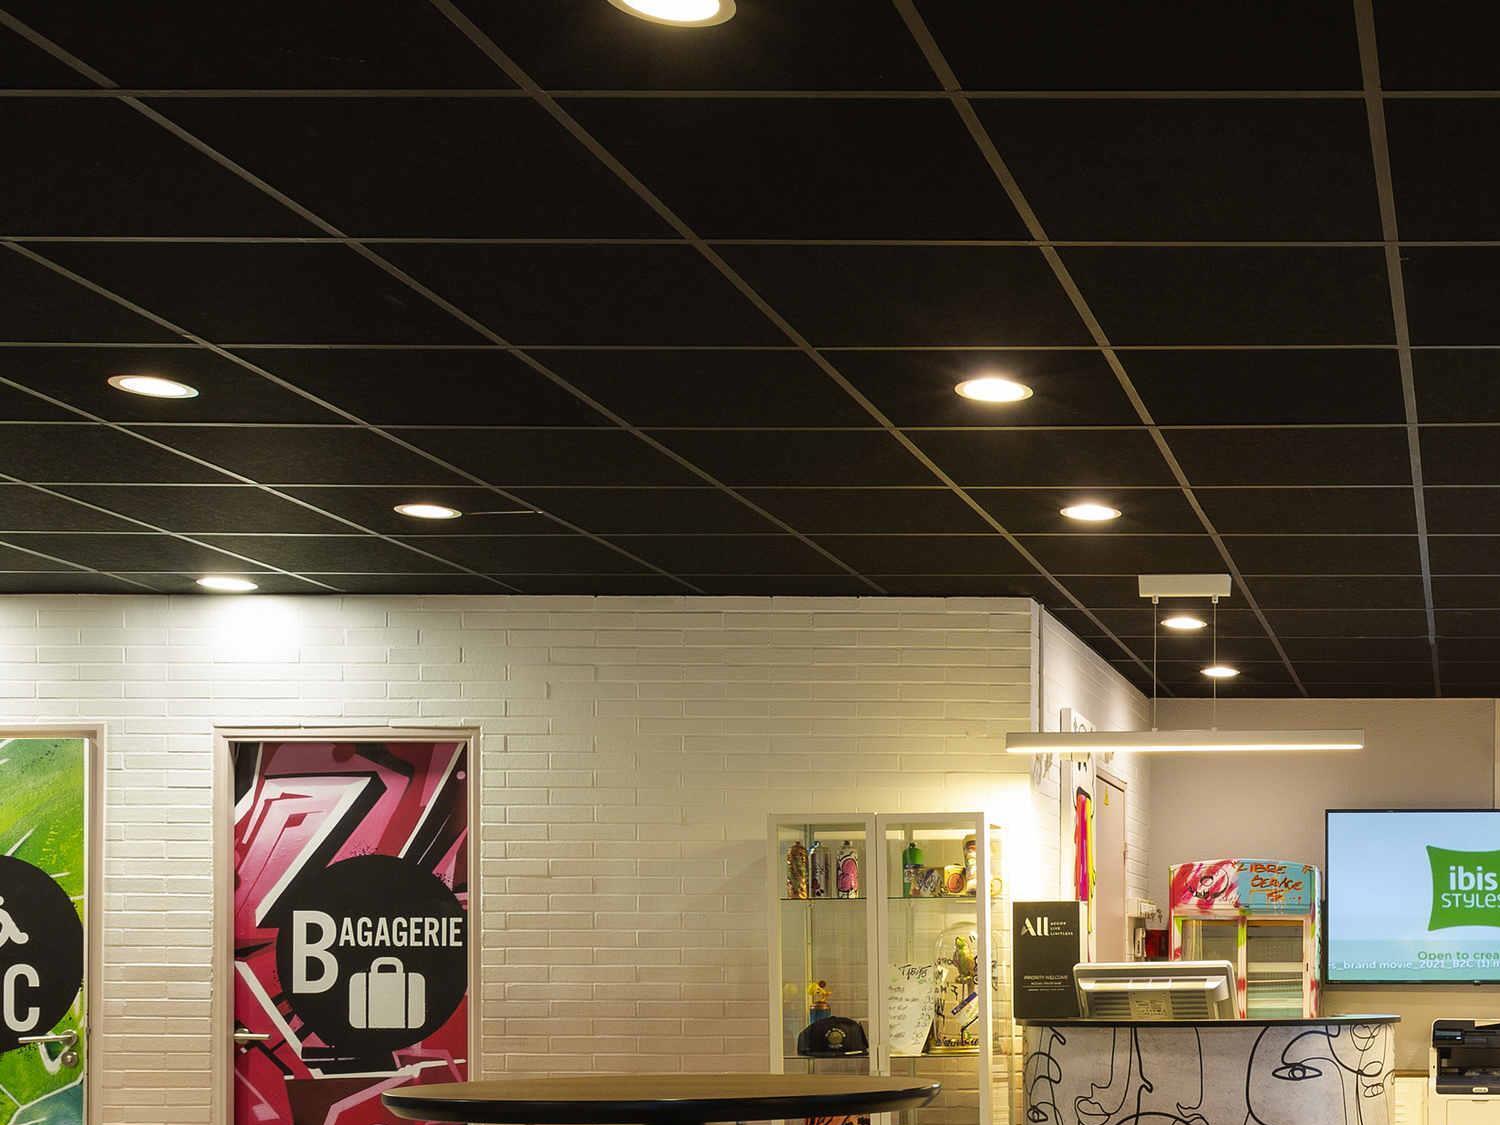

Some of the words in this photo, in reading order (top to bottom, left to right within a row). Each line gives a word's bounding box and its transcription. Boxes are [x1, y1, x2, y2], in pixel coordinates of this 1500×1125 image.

[1449, 865, 1498, 891] ibis
[292, 910, 464, 994] BAGAGERIE
[1417, 951, 1453, 961] Open
[1456, 951, 1470, 961] to
